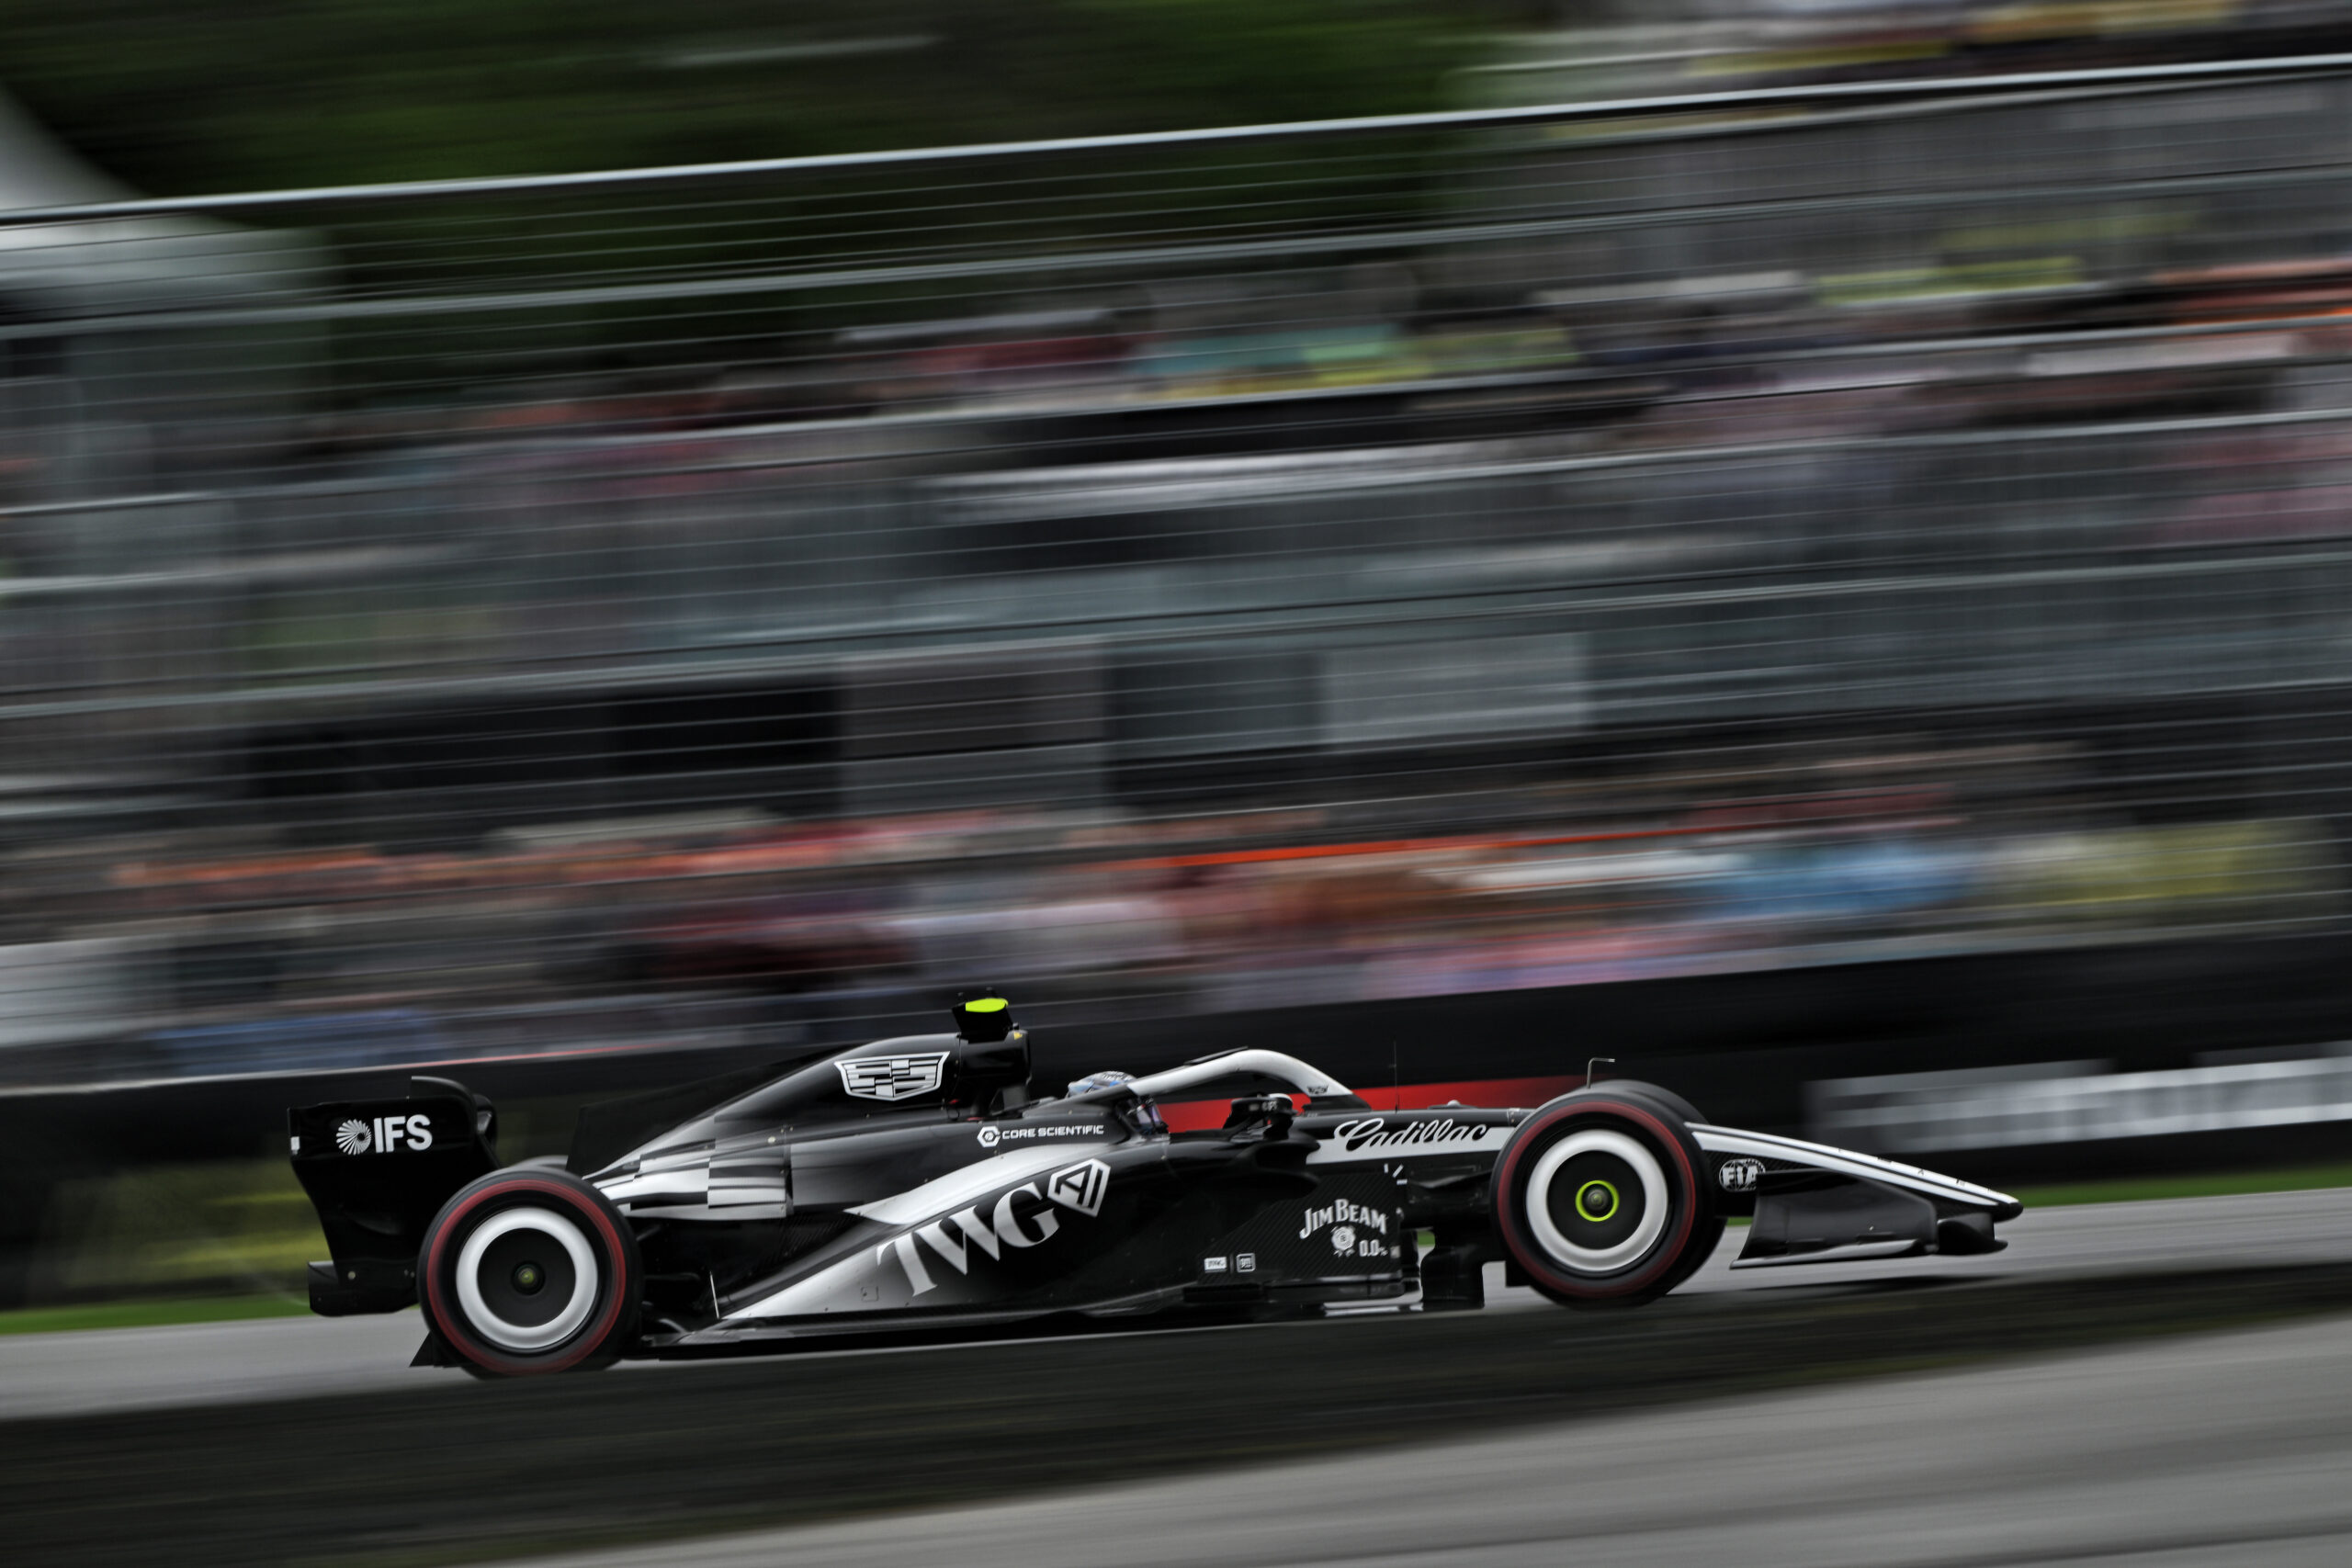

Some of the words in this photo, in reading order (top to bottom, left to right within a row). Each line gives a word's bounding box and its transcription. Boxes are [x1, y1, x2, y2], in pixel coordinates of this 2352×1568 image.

[374, 1114, 433, 1153] IFS
[1002, 1128, 1036, 1140] CORE
[1038, 1124, 1104, 1137] SCIENTIFIC
[1334, 1118, 1487, 1151] Cadillac
[876, 1181, 1059, 1296] TWG
